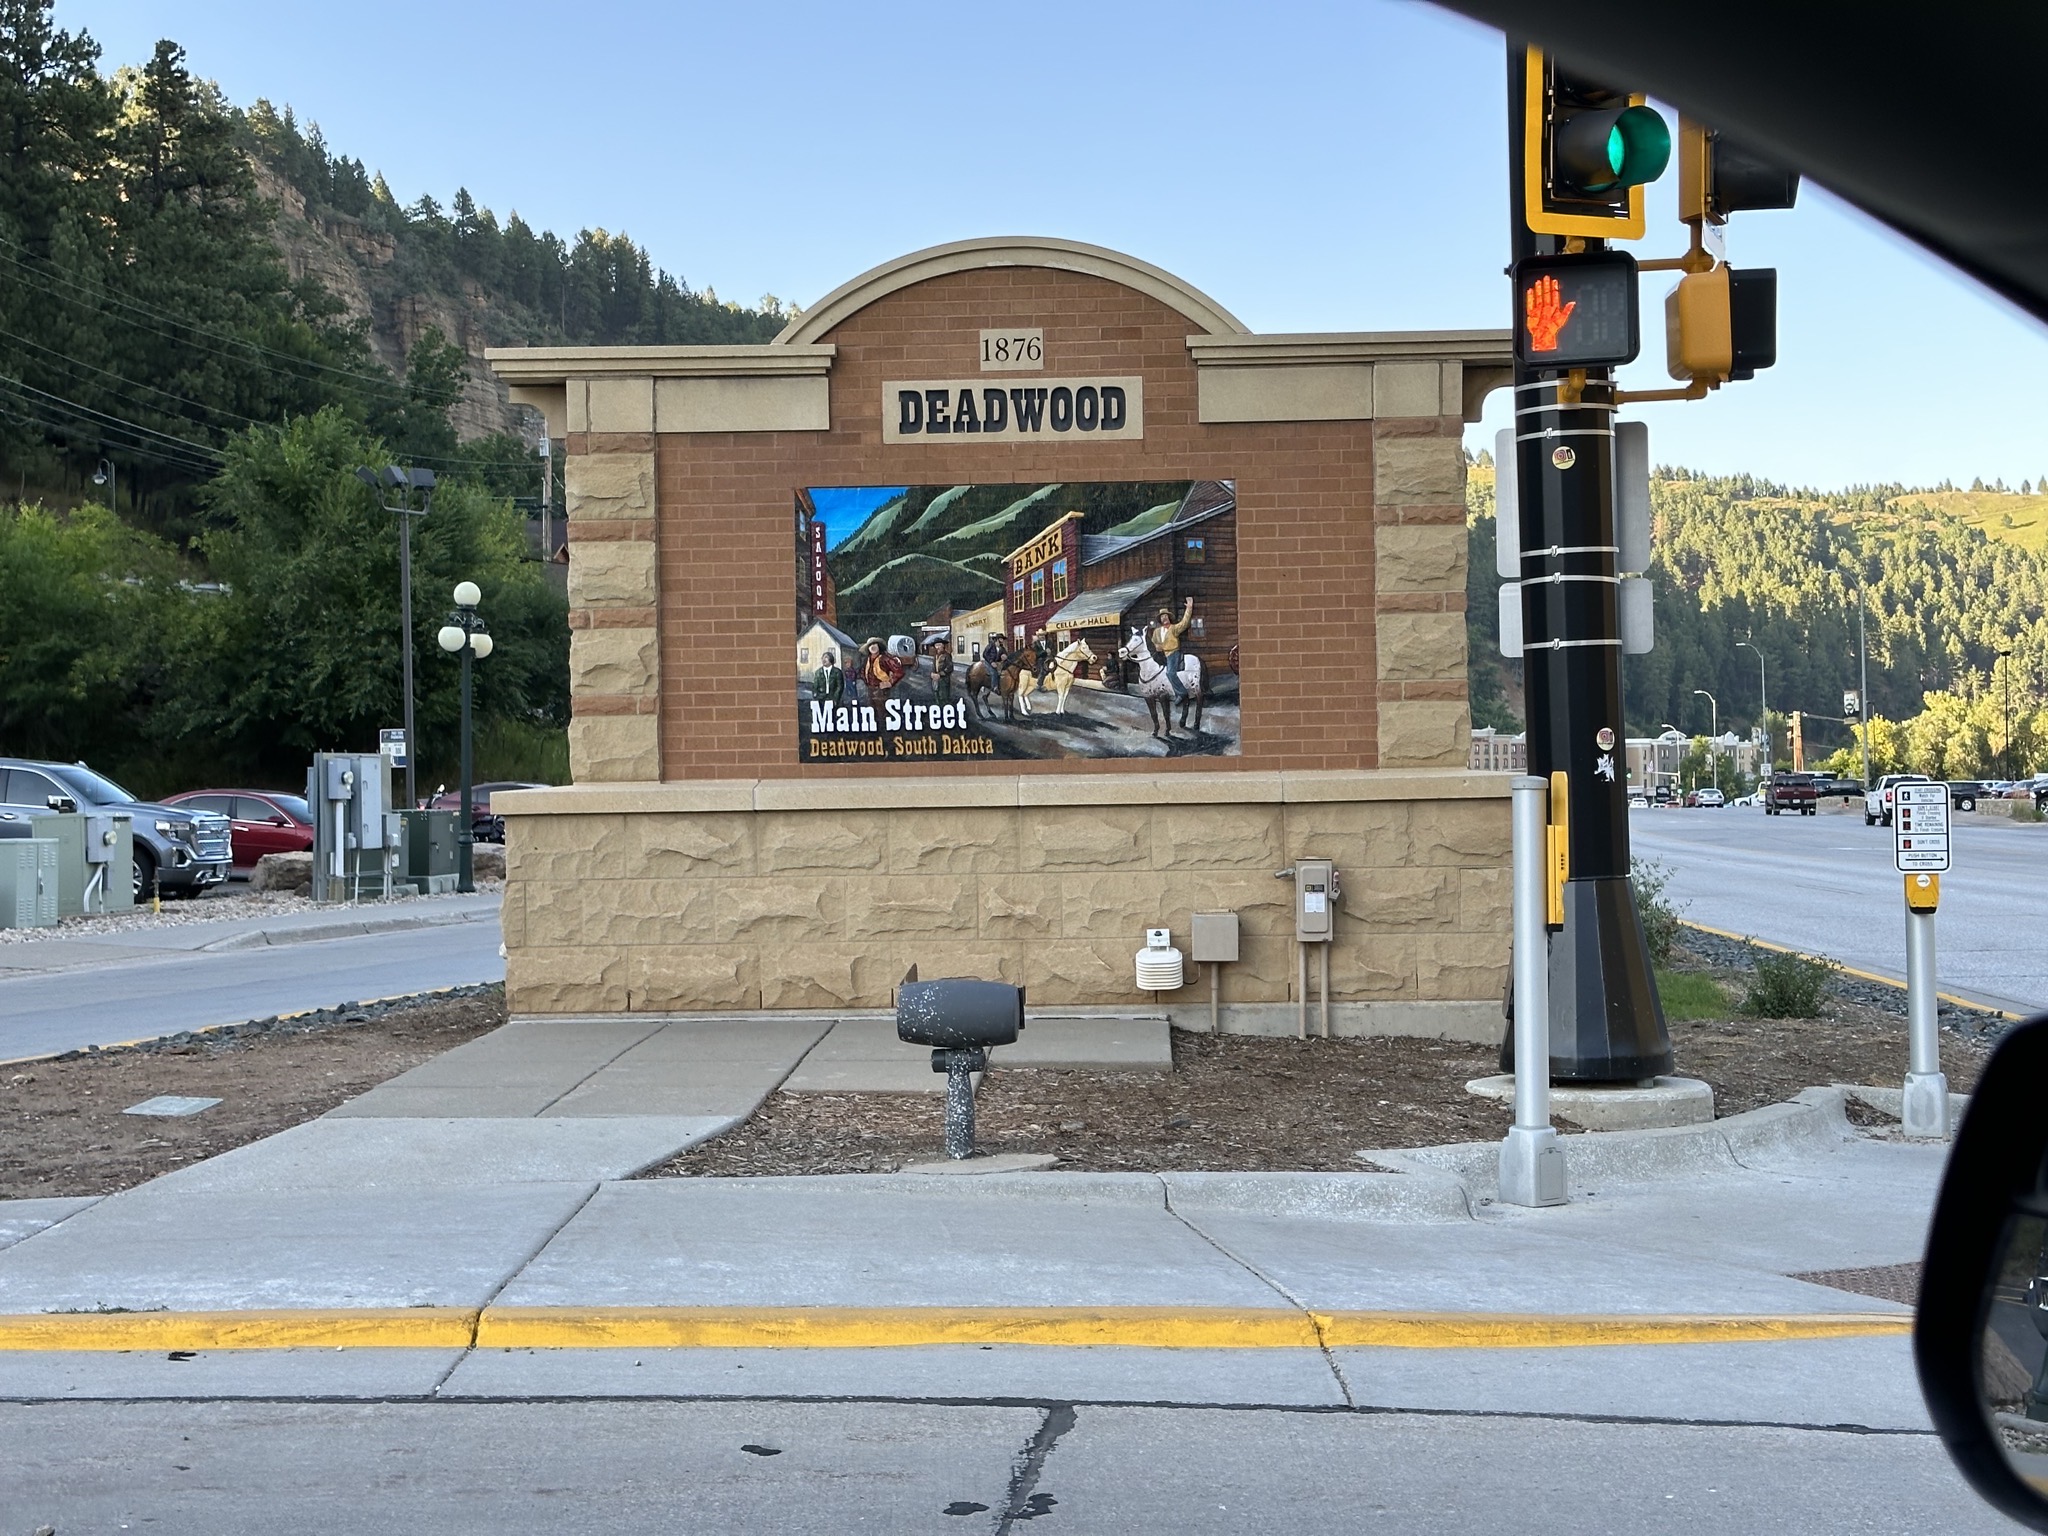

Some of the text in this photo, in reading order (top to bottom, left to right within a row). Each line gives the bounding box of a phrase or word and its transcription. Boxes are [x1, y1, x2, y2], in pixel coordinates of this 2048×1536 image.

[982, 337, 1042, 362] 1876
[898, 385, 1127, 434] DEADWOOD
[815, 526, 824, 610] SALOON
[1015, 532, 1060, 576] BANK
[1055, 620, 1078, 630] CELLA
[1087, 616, 1110, 626] HALL
[810, 697, 967, 733] Main Street
[809, 734, 993, 758] Deadwood, South Dakota
